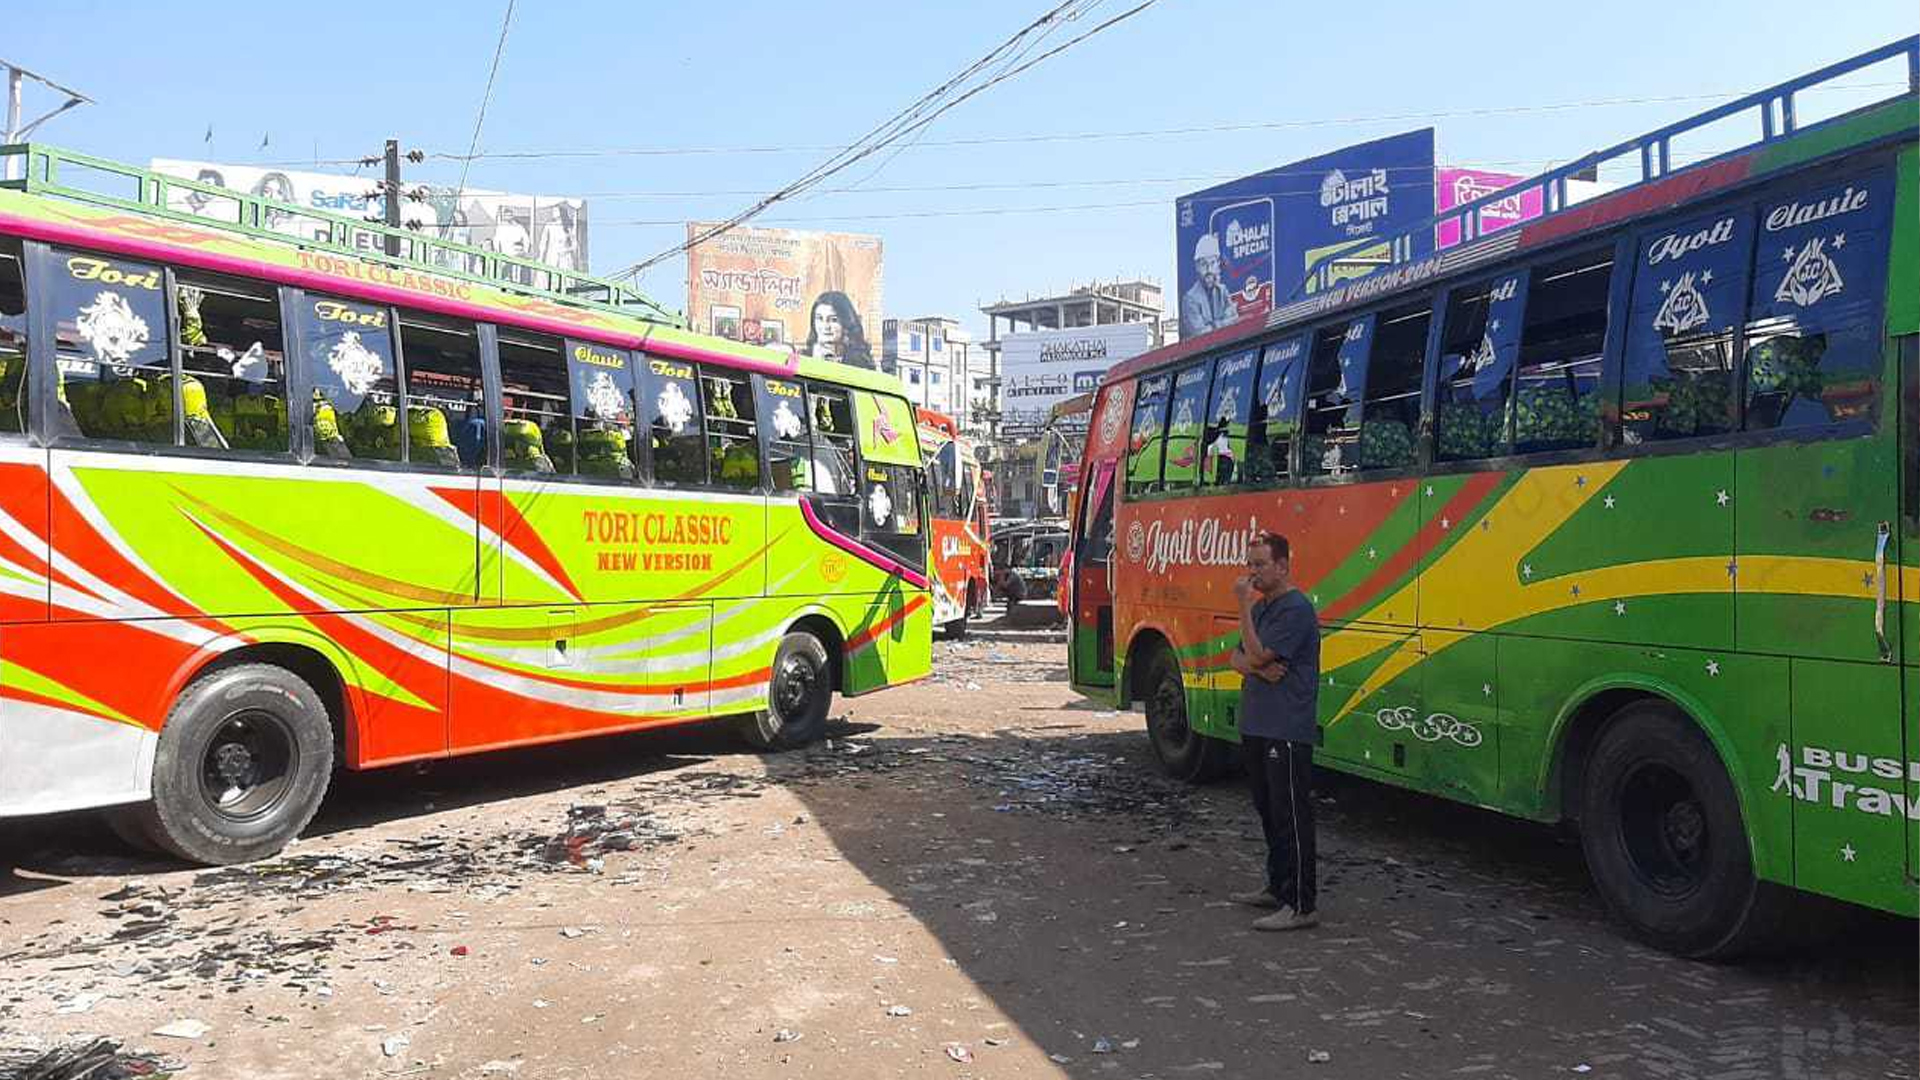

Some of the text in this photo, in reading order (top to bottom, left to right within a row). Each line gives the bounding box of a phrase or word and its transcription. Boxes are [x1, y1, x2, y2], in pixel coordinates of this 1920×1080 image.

[1765, 187, 1868, 231] Classic
[1233, 222, 1270, 243] DHALAI
[1648, 218, 1735, 265] Jyoti
[1233, 240, 1270, 259] SPECIAL
[67, 257, 161, 290] Tori
[296, 252, 472, 299] TORI CLASSIC
[314, 301, 386, 328] Tori
[575, 346, 624, 368] Classic
[650, 359, 694, 379] Tori
[766, 380, 801, 398] Tori
[583, 510, 731, 546] TORI CLASSIC
[1146, 518, 1196, 574] Jyoti
[597, 552, 712, 572] NEW VERSION
